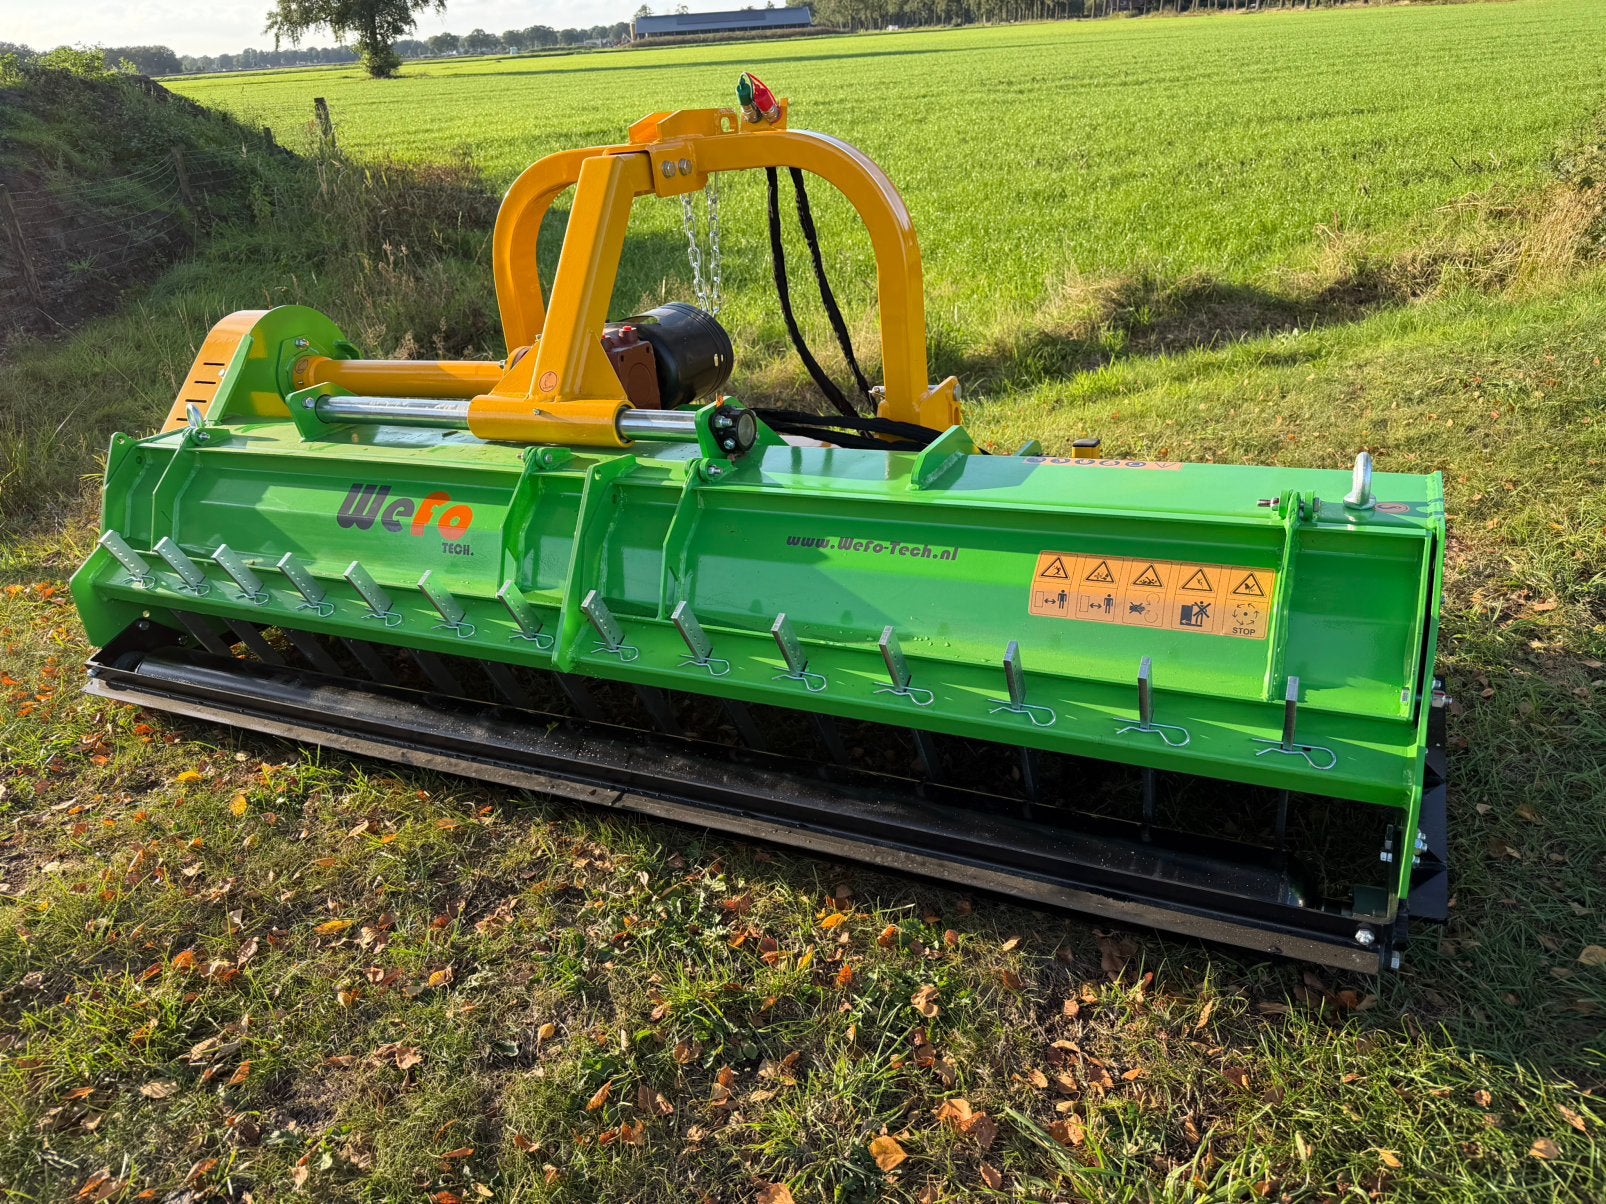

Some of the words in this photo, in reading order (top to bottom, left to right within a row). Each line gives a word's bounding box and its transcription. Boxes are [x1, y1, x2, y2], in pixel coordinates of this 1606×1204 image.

[441, 543, 474, 556] TECH.
[786, 535, 960, 561] www.Wefo-Tech.nl
[1232, 627, 1256, 635] STOP
